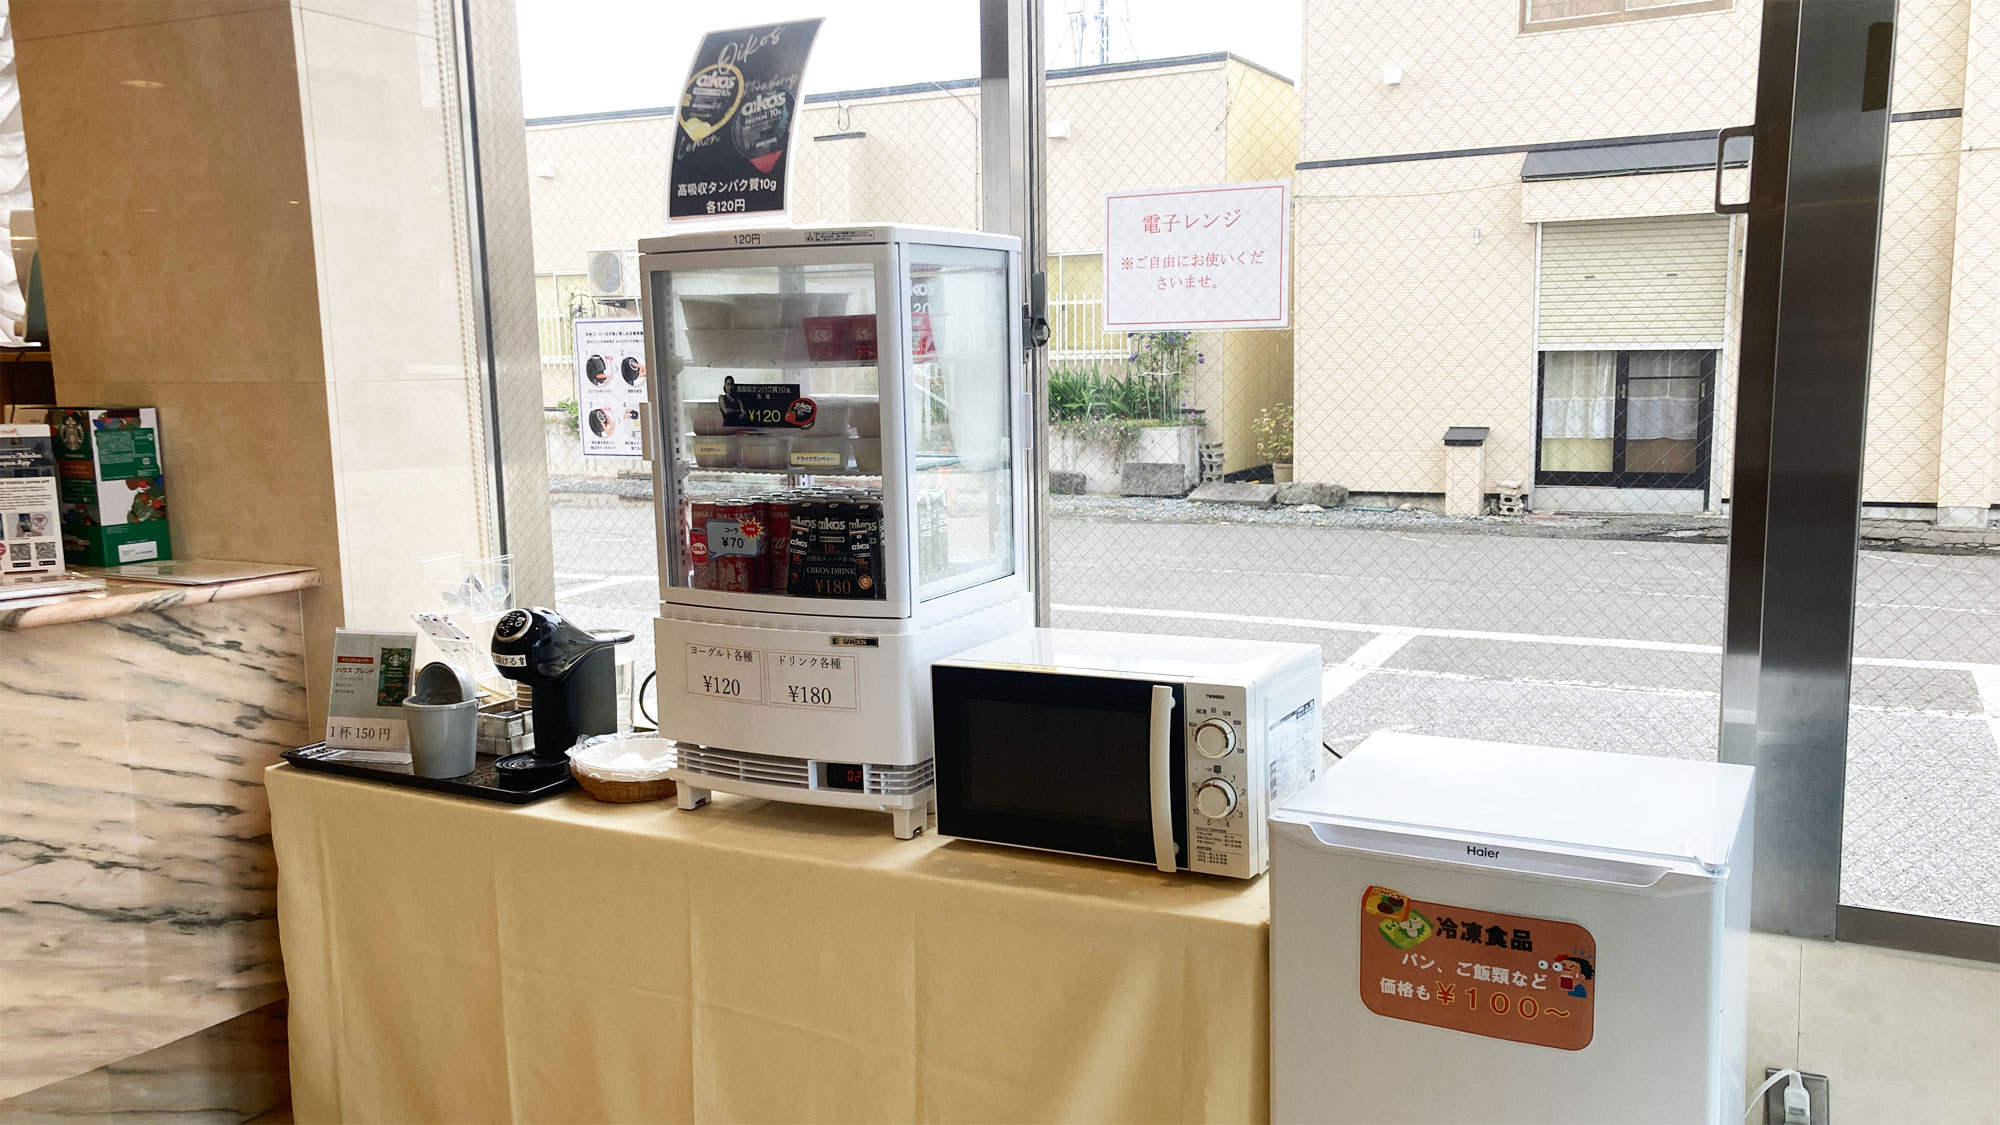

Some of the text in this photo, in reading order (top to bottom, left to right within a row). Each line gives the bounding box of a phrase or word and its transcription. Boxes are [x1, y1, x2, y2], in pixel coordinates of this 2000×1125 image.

[677, 178, 776, 197] 高吸収タンパク質10g
[706, 199, 746, 213] 各120円
[1143, 208, 1242, 234] 電子レンジ
[734, 234, 760, 245] 120円
[1121, 250, 1265, 271] ※ご自由にお使いくだ
[1156, 275, 1219, 290] さいませ。
[748, 409, 781, 422] ¥120
[818, 518, 846, 530] oikos
[722, 537, 744, 548] ¥70
[790, 538, 808, 548] oikos
[851, 542, 870, 551] oikos
[806, 566, 856, 575] OIKOS DRINK
[815, 579, 851, 594] ¥180
[690, 646, 753, 663] ヨーグルト各種
[779, 655, 842, 670] ドリンク各種
[703, 675, 741, 697] ¥120
[788, 685, 832, 706] ¥180
[1466, 845, 1500, 860] Haier
[1436, 917, 1533, 952] 冷凍食品
